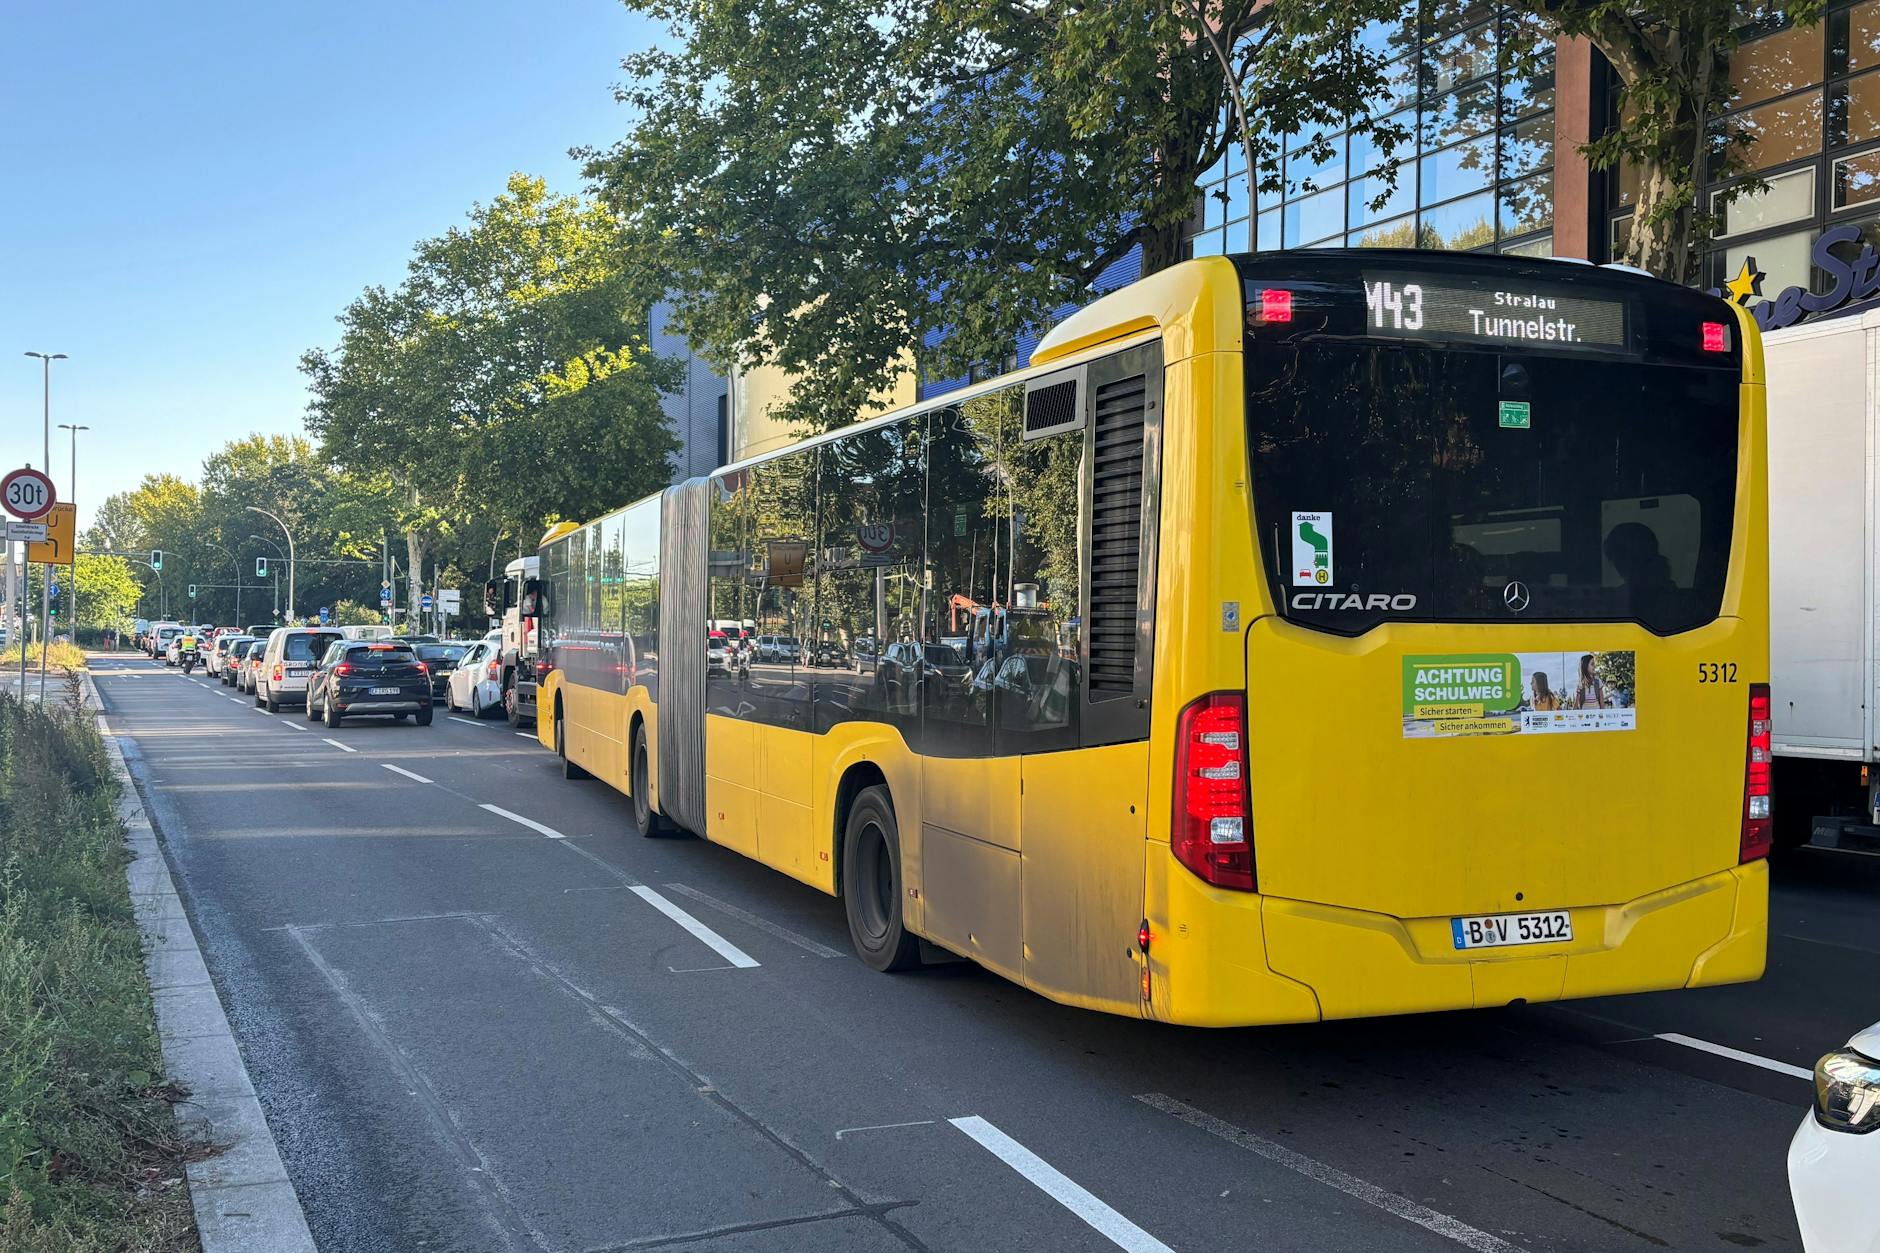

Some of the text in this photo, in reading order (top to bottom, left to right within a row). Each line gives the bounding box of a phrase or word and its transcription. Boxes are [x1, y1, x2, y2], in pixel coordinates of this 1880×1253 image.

[1363, 281, 1424, 330] M43
[1494, 291, 1556, 310] Stralau
[1469, 309, 1582, 343] Tunnelstr.
[10, 482, 42, 505] 30t
[1292, 593, 1417, 611] CITARO
[1415, 668, 1503, 685] ACHTUNG
[1699, 663, 1737, 683] 5312
[1420, 708, 1444, 716] Sicher
[1445, 707, 1472, 715] starten
[1440, 721, 1507, 731] Sicher ankommen
[1518, 915, 1567, 940] 5312
